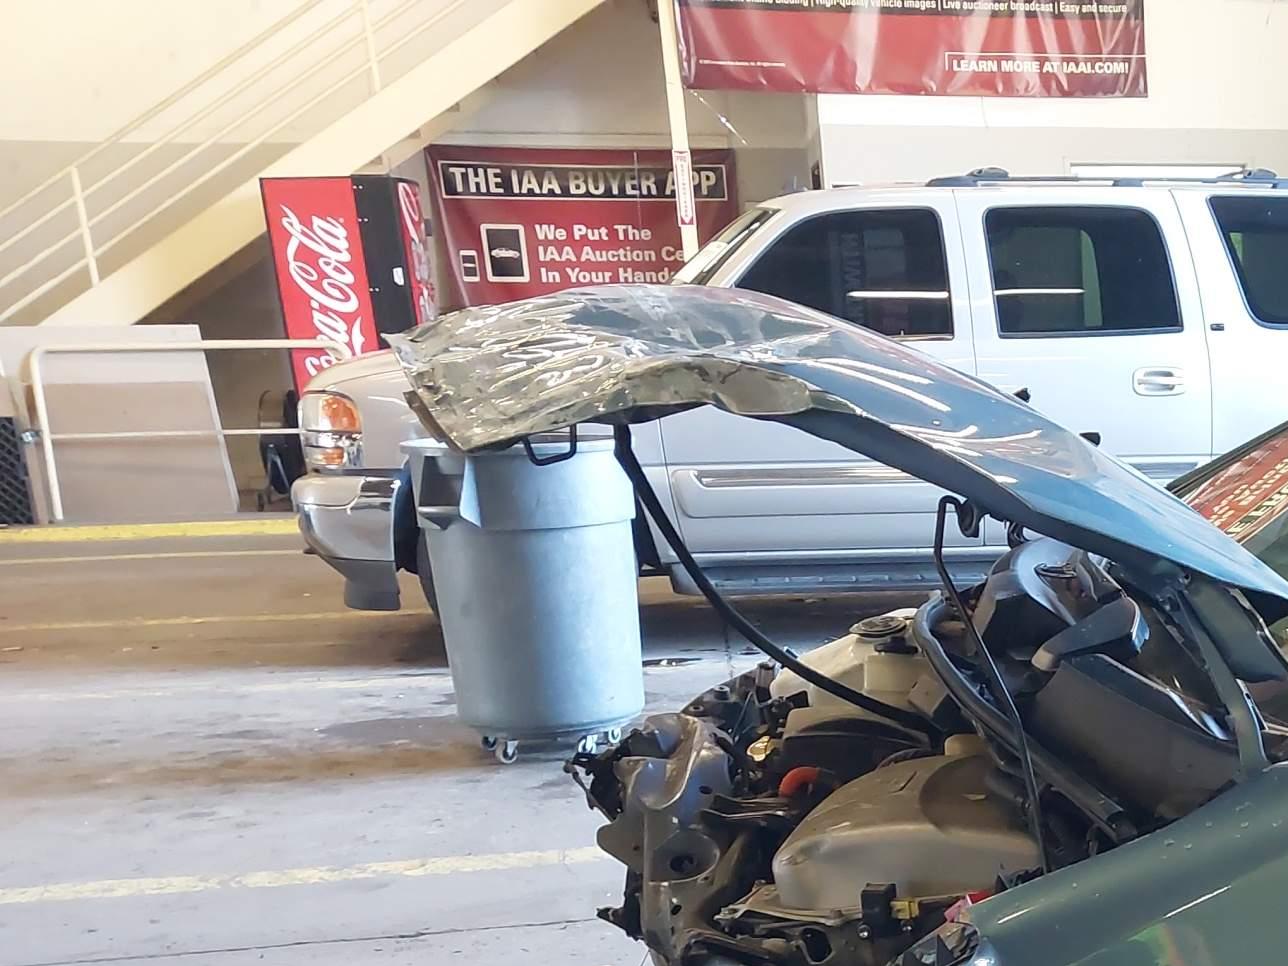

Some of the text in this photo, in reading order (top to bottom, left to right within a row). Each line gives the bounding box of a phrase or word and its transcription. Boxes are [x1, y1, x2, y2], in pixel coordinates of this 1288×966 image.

[903, 0, 936, 10] images
[943, 0, 961, 9] Live
[1010, 1, 1053, 11] broadcast
[1060, 2, 1080, 14] Easy
[1082, 3, 1097, 12] and
[1098, 4, 1128, 13] secure
[952, 59, 1129, 74] LEARN MORE AT IAAI.COM!
[449, 167, 504, 194] THE
[511, 169, 561, 195] IAA
[569, 170, 657, 196] BUYER
[535, 224, 651, 241] We Put The
[538, 246, 577, 262] IAA
[580, 246, 656, 262] Auction
[540, 267, 560, 283] In
[565, 267, 612, 283] Your
[279, 203, 359, 377] oa-Cola
